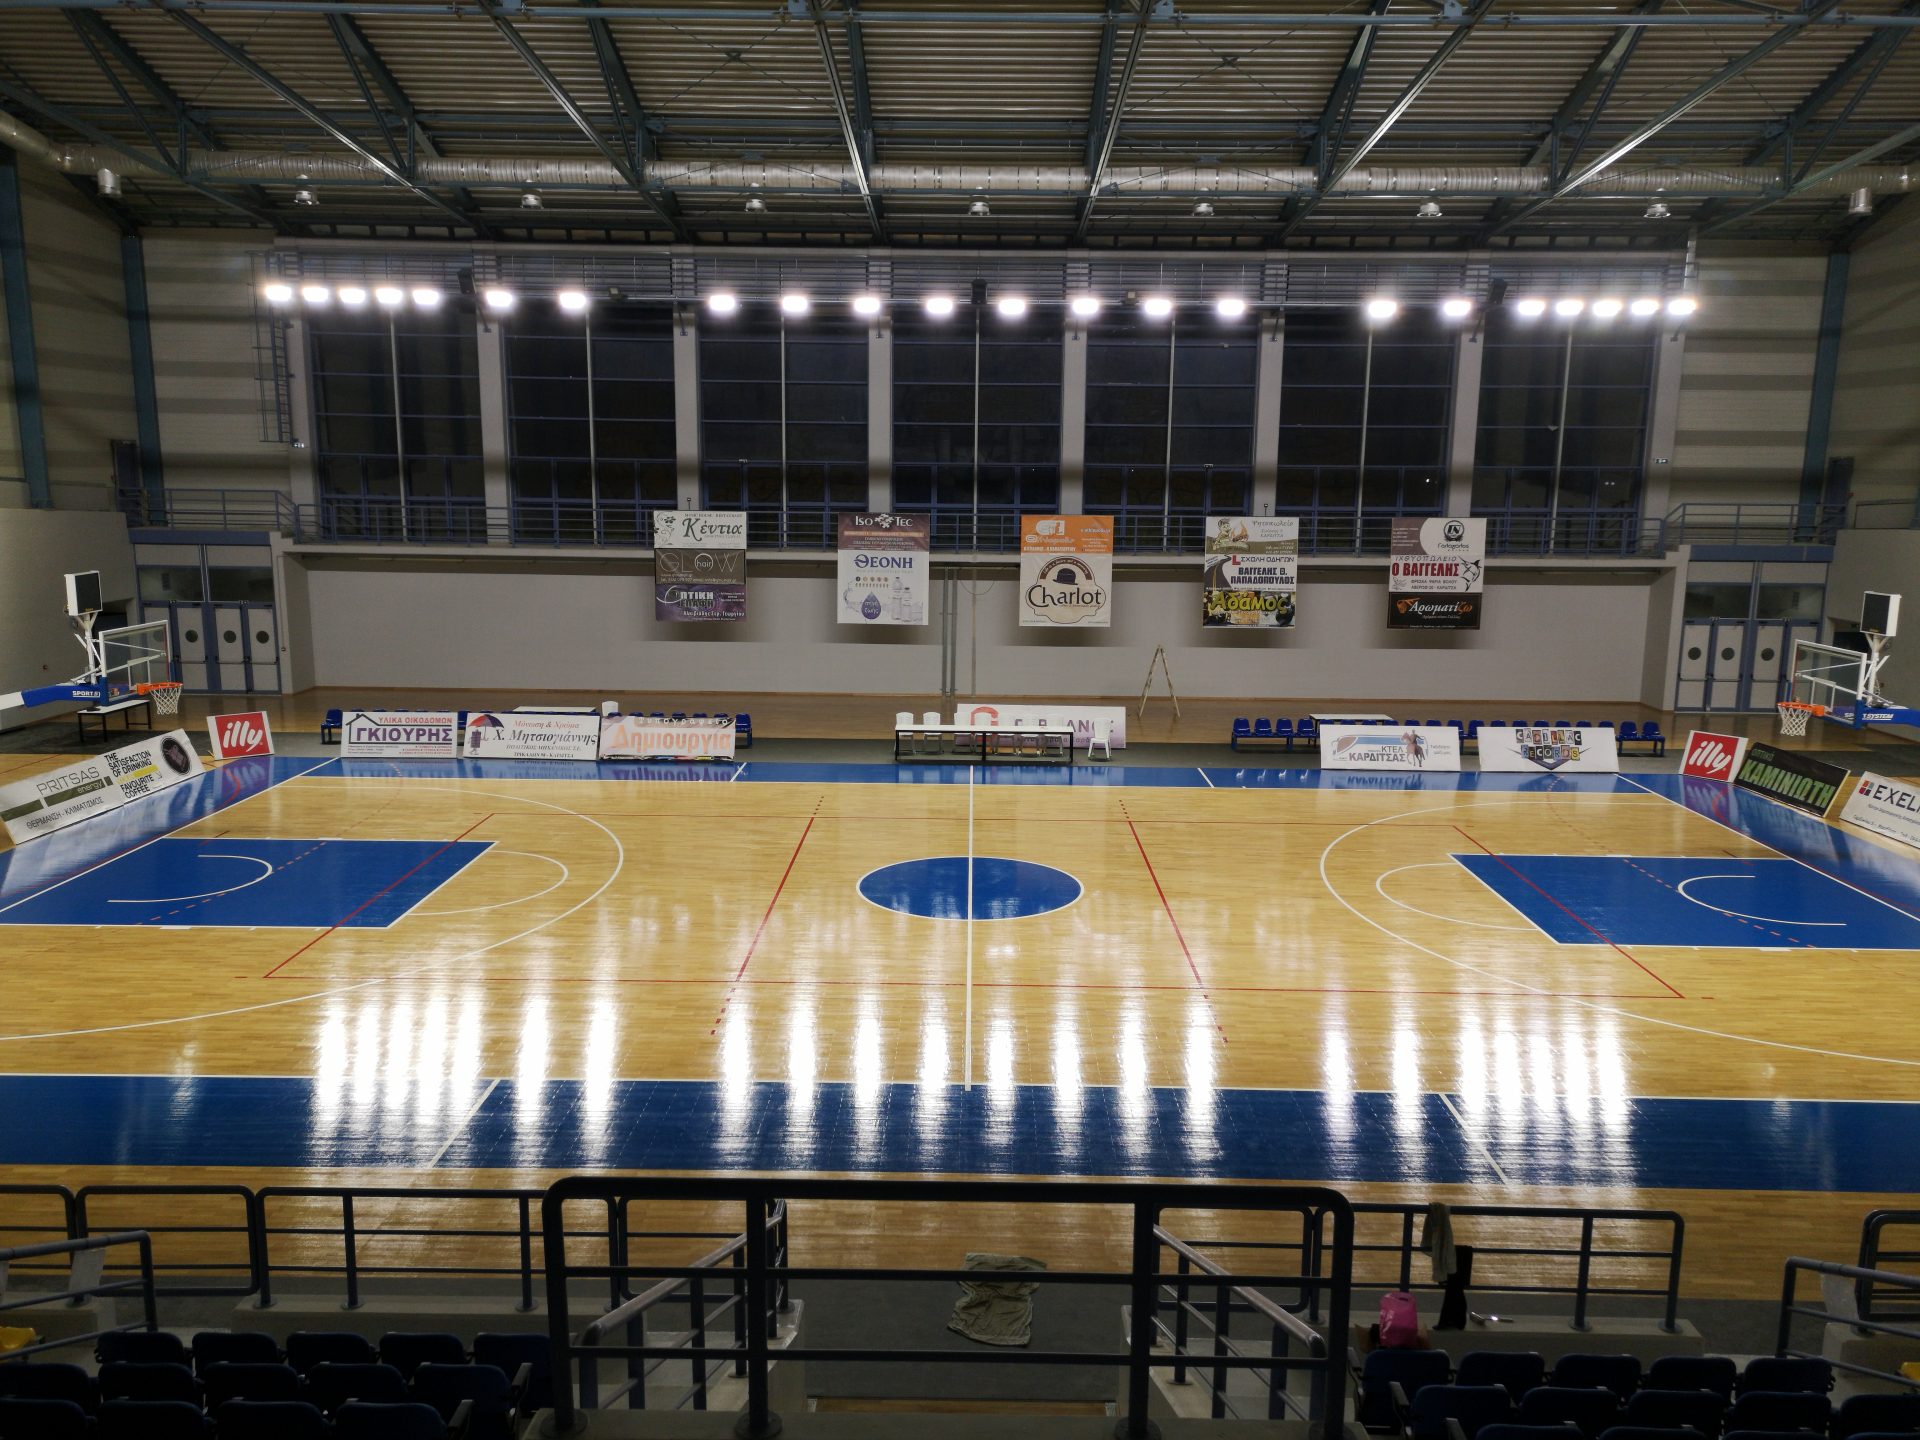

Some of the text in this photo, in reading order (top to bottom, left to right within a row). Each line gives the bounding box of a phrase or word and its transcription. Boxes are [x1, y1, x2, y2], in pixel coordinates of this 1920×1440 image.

[682, 518, 743, 541] Κέντια
[660, 553, 739, 573] GLOW
[696, 560, 712, 568] hair
[854, 554, 913, 569] ΘΕΟΝΗ
[1402, 562, 1460, 577] ΒΑΓΓΕΛΗΣ
[1238, 567, 1278, 576] ΒΑΓΓΕΛΗΣ
[1230, 576, 1295, 585] ΠΑΠΑΔΟΠΟΥΛΟΣ
[1028, 585, 1102, 608] Charlot
[223, 721, 263, 752] illy
[356, 728, 453, 742] ΓΚΙΟΥΡΗΣ
[510, 729, 598, 746] Μητσιογιάννης
[609, 724, 731, 754] Δημιουργία
[1516, 728, 1582, 745] CADILLAC
[104, 752, 119, 763] THE
[1349, 752, 1406, 762] ΚΑΡΔΙΤΣΑΣ
[1381, 745, 1403, 753] ΚΤΕΛ
[1521, 745, 1580, 760] RECORDS
[1689, 741, 1732, 774] illy
[108, 749, 152, 771] SATISFACTION
[112, 758, 152, 778] OF DRINKING
[36, 766, 100, 795] PRITSAS
[77, 780, 102, 794] energy
[120, 774, 154, 792] FAVOURITE
[124, 784, 151, 799] COFFEE
[1873, 784, 1920, 813] EXEL
[26, 796, 104, 829] ΘΕΡΜΑΝΣΗ ΚΛΙΜΑΤΙΣΜΟΣ
